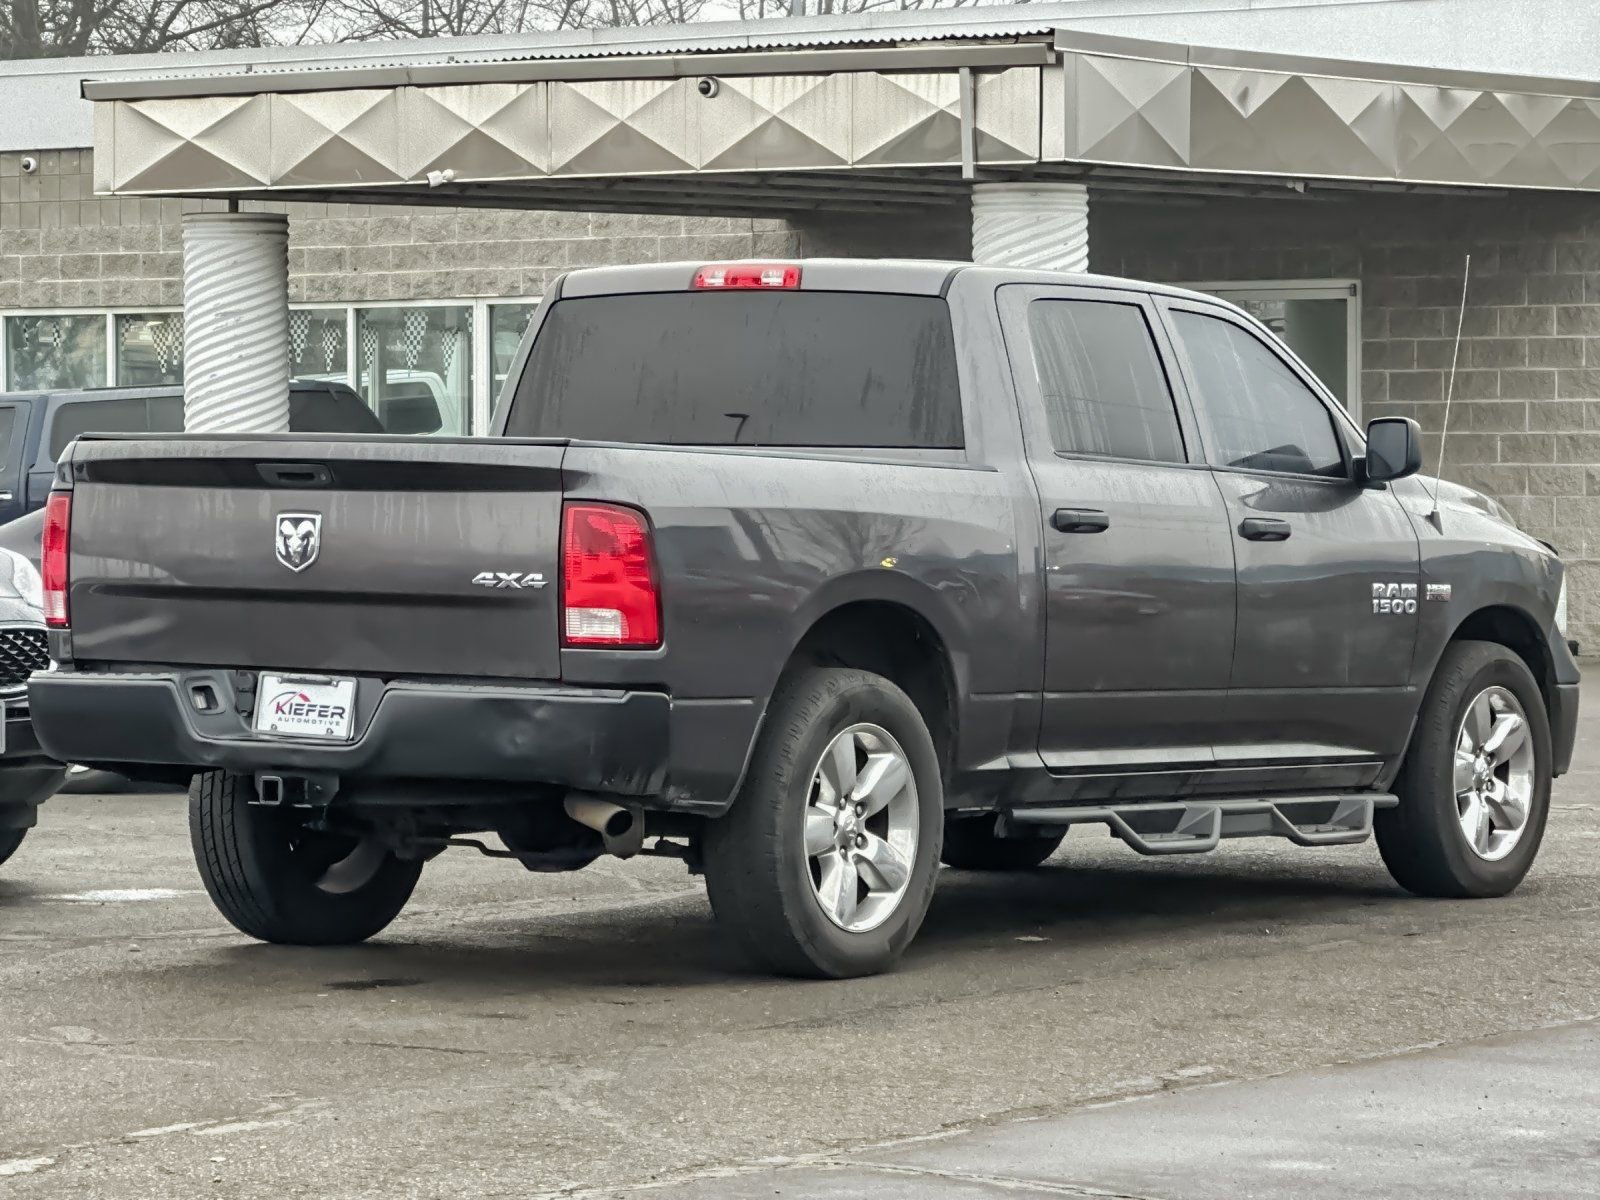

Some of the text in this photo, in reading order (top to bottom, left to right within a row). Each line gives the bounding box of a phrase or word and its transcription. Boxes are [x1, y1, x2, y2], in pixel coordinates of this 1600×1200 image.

[1372, 583, 1418, 598] RAM
[1372, 598, 1418, 614] 1500
[275, 701, 346, 720] KIEFER
[277, 716, 341, 727] AUTOMOTIVE
